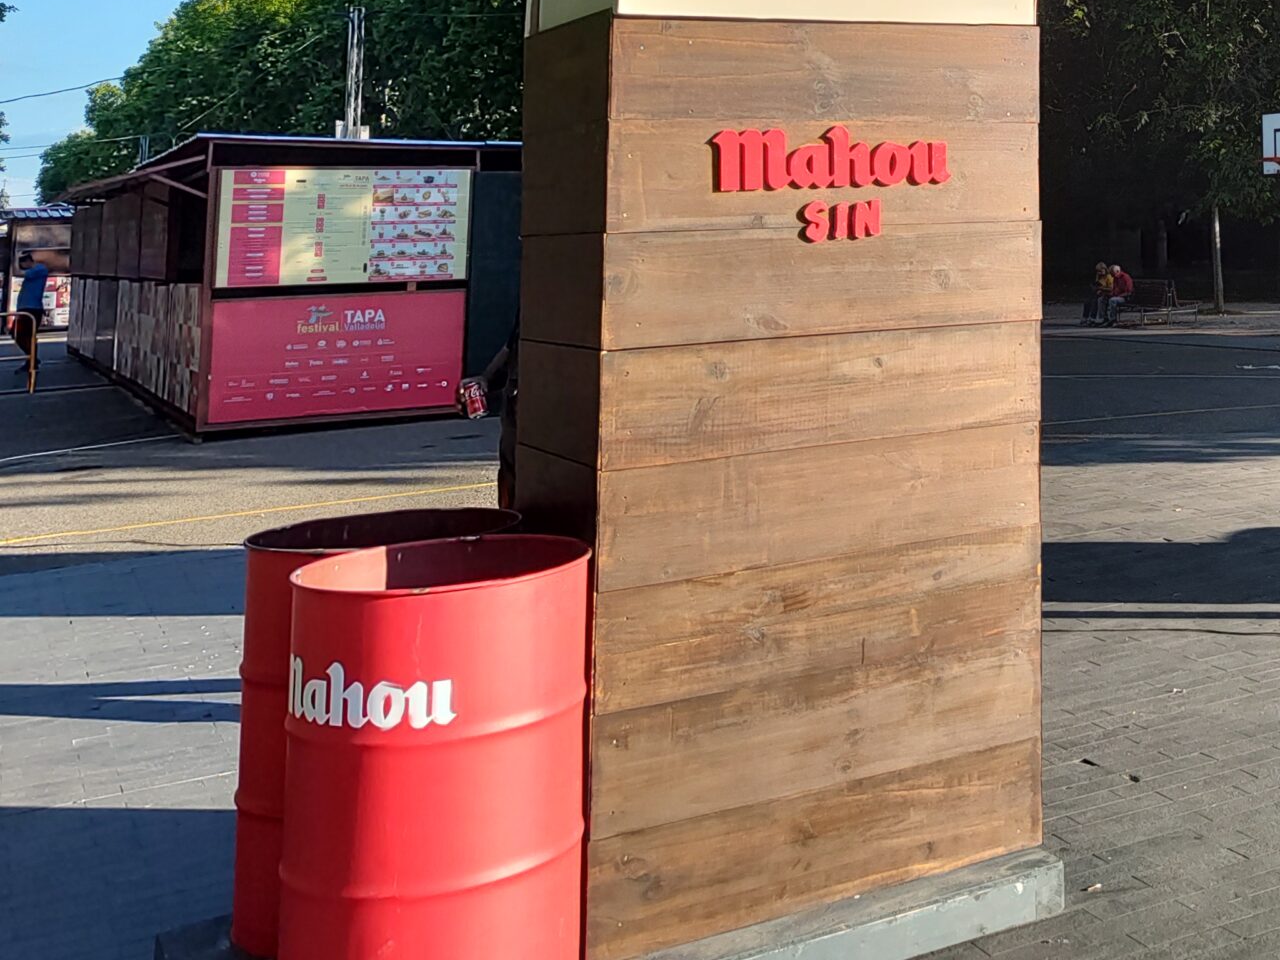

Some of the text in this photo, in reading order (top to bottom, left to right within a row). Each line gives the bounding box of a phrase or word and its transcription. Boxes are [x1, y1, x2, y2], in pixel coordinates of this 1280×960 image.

[706, 124, 951, 193] Mahou
[796, 197, 882, 244] SIN
[297, 320, 340, 334] festival
[344, 308, 386, 324] TAPA
